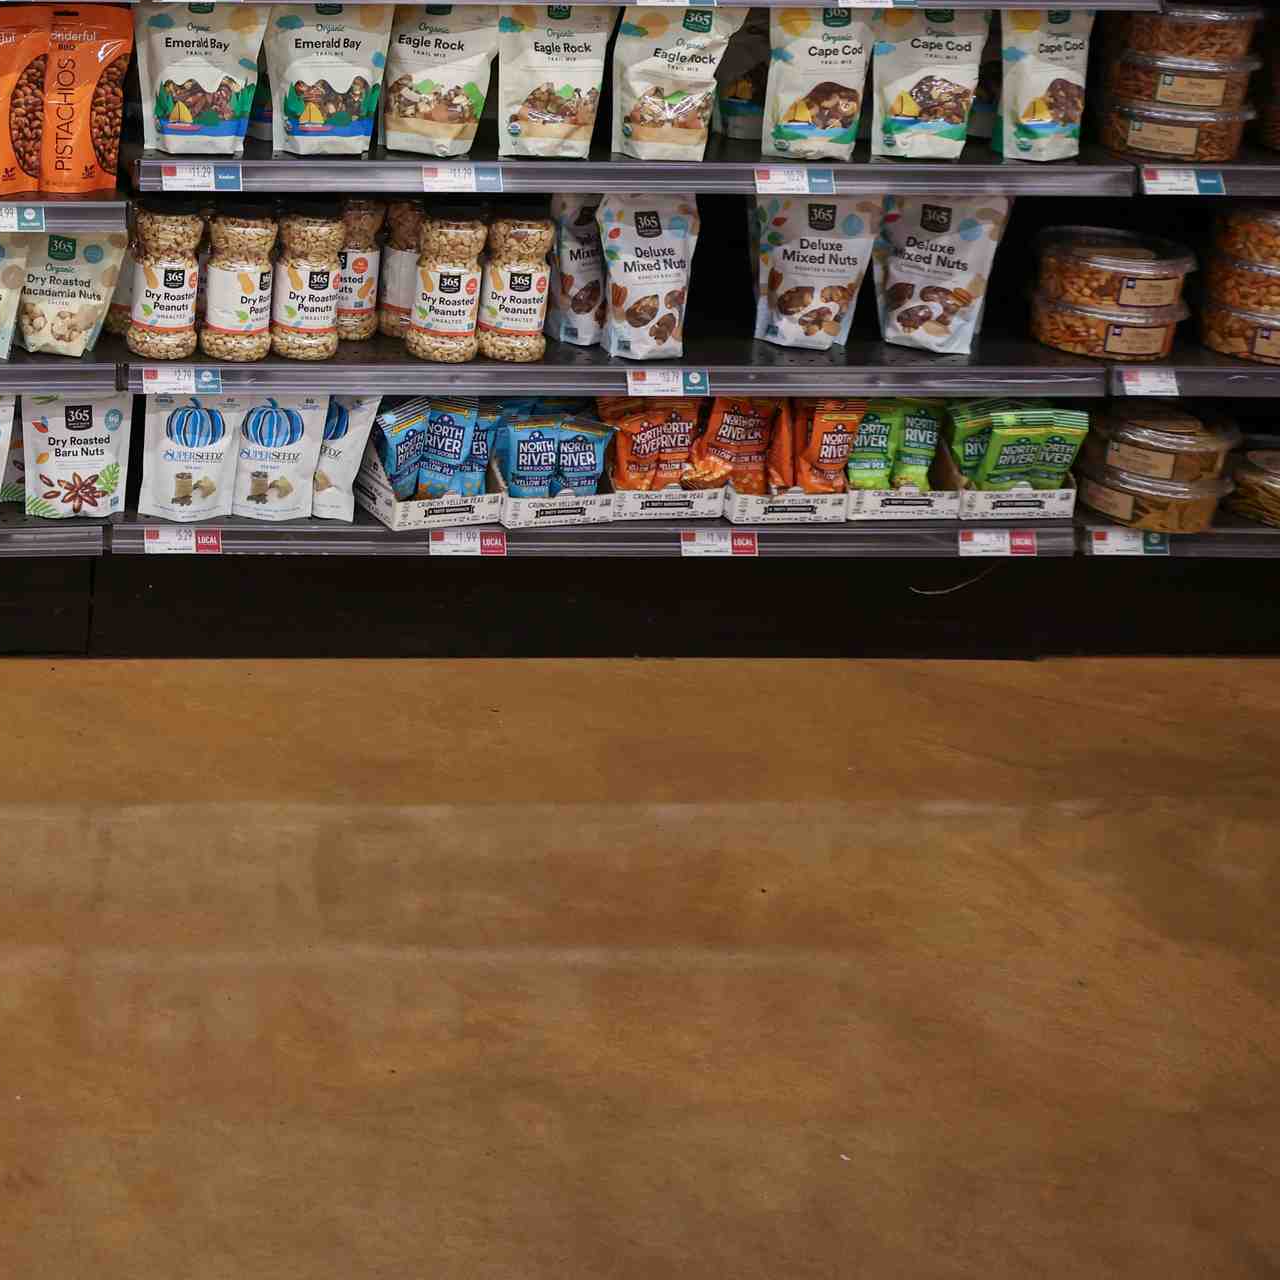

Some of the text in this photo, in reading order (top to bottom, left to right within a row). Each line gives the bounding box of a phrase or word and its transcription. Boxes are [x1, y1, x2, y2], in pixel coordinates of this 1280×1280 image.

[294, 37, 361, 52] Emerald Bay
[534, 42, 592, 56] Eagle Rock
[800, 238, 842, 253] Deluxe
[782, 250, 857, 266] Mixed Nuts
[422, 294, 474, 307] Dry Roasted
[428, 305, 466, 316] Peanuts
[68, 406, 90, 421] 365
[49, 435, 110, 449] Dry Roasted
[518, 441, 554, 454] NORTH
[560, 441, 593, 452] NORTH
[54, 446, 104, 458] Baru Nuts
[518, 453, 556, 467] RIVER
[560, 453, 595, 466] RIVER
[198, 536, 218, 545] LOCAL
[482, 538, 504, 548] LOCAL
